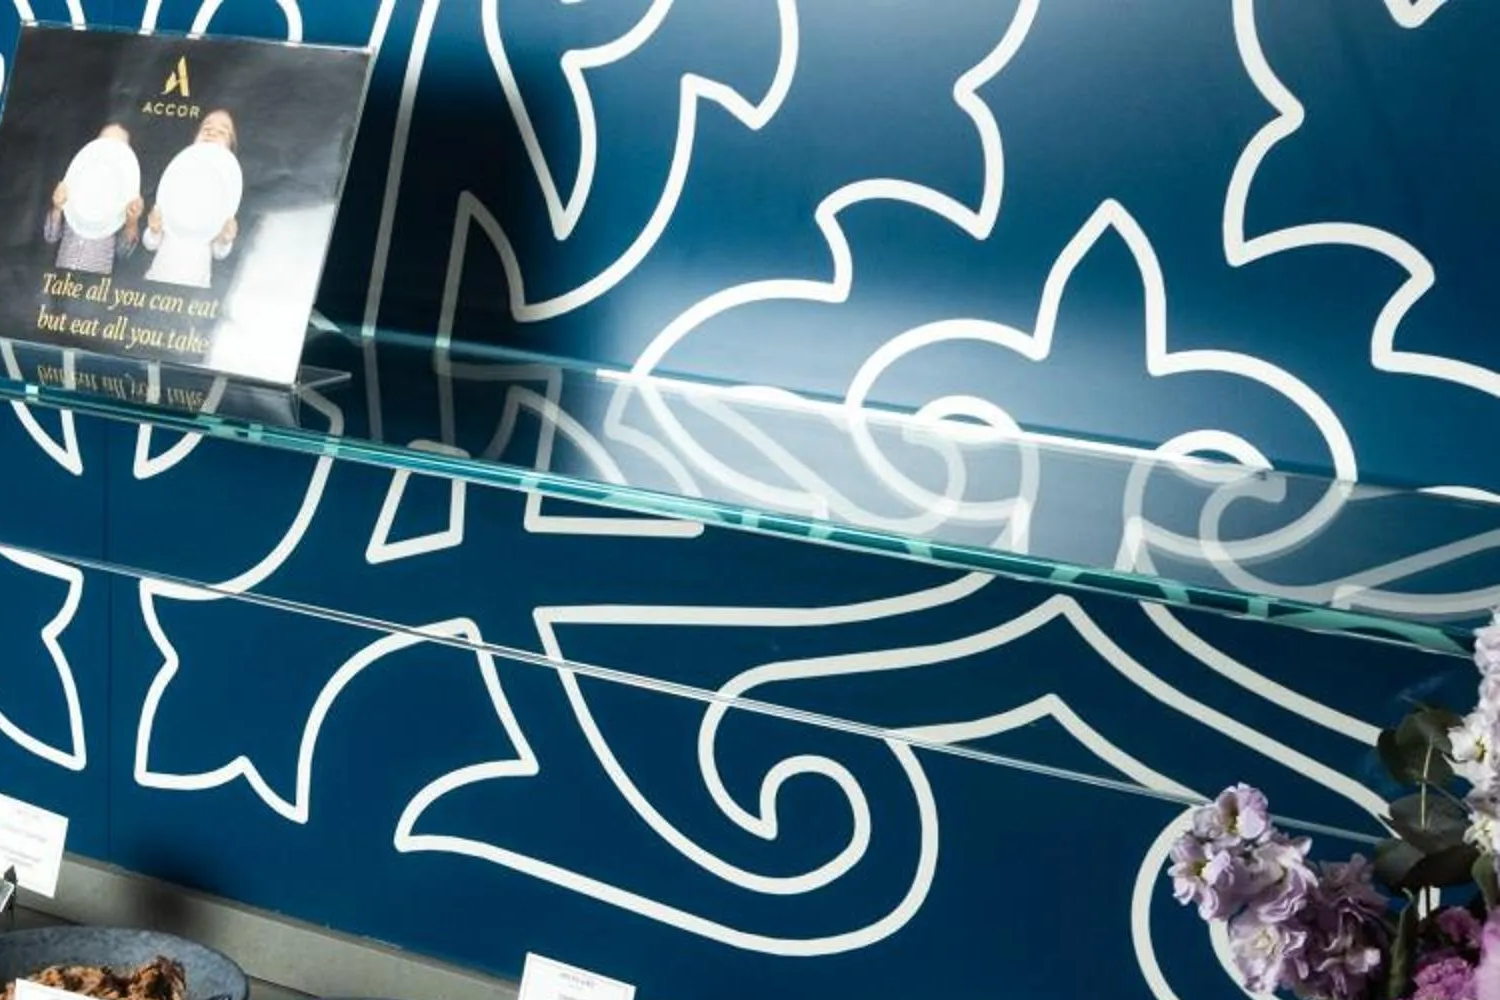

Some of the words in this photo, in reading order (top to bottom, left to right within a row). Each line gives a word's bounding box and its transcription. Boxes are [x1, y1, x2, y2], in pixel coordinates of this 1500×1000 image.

[142, 101, 201, 119] ACCOR
[42, 272, 84, 299] Take
[86, 276, 111, 302] all
[108, 291, 145, 311] you
[150, 293, 183, 313] can
[187, 298, 219, 319] eat
[37, 303, 67, 332] but
[69, 315, 100, 337] eat
[103, 315, 128, 341] all
[124, 326, 162, 350] you
[168, 326, 211, 353] take
